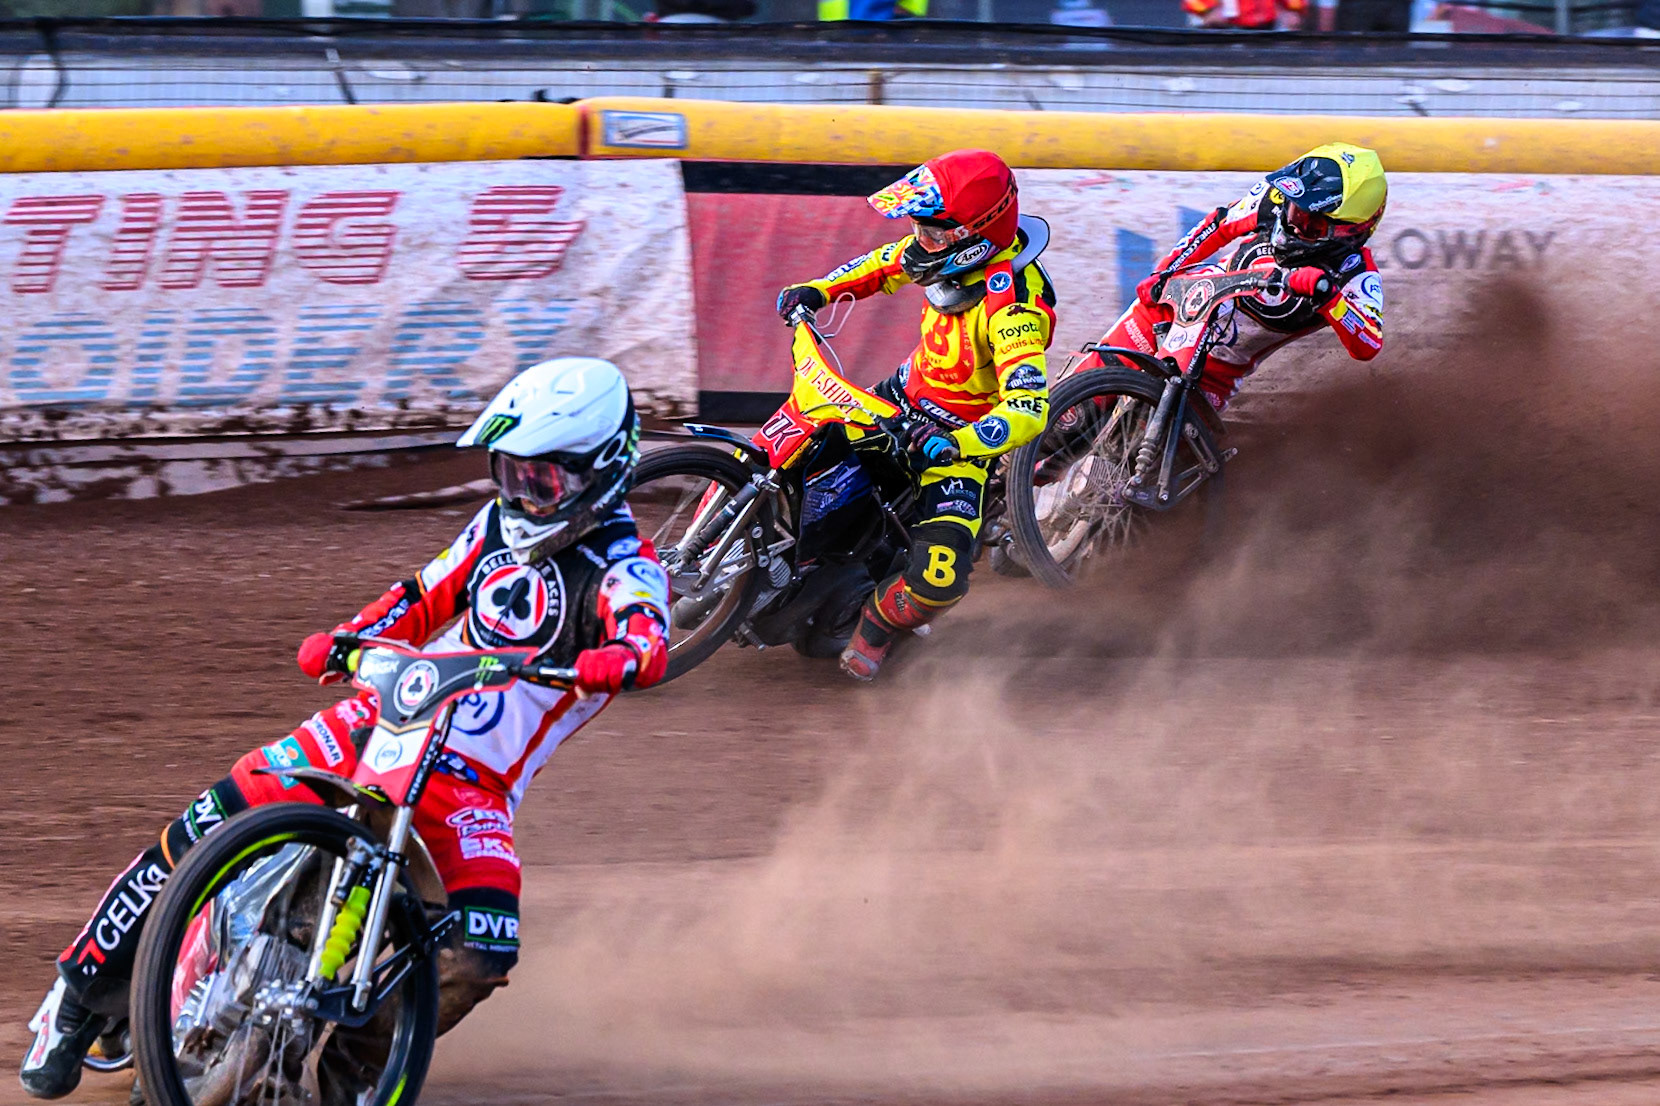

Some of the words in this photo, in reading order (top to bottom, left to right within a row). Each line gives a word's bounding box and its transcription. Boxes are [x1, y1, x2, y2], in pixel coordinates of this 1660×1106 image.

[3, 188, 401, 294] TING
[481, 553, 513, 576] BELL
[547, 580, 560, 617] ACES
[922, 545, 957, 588] B
